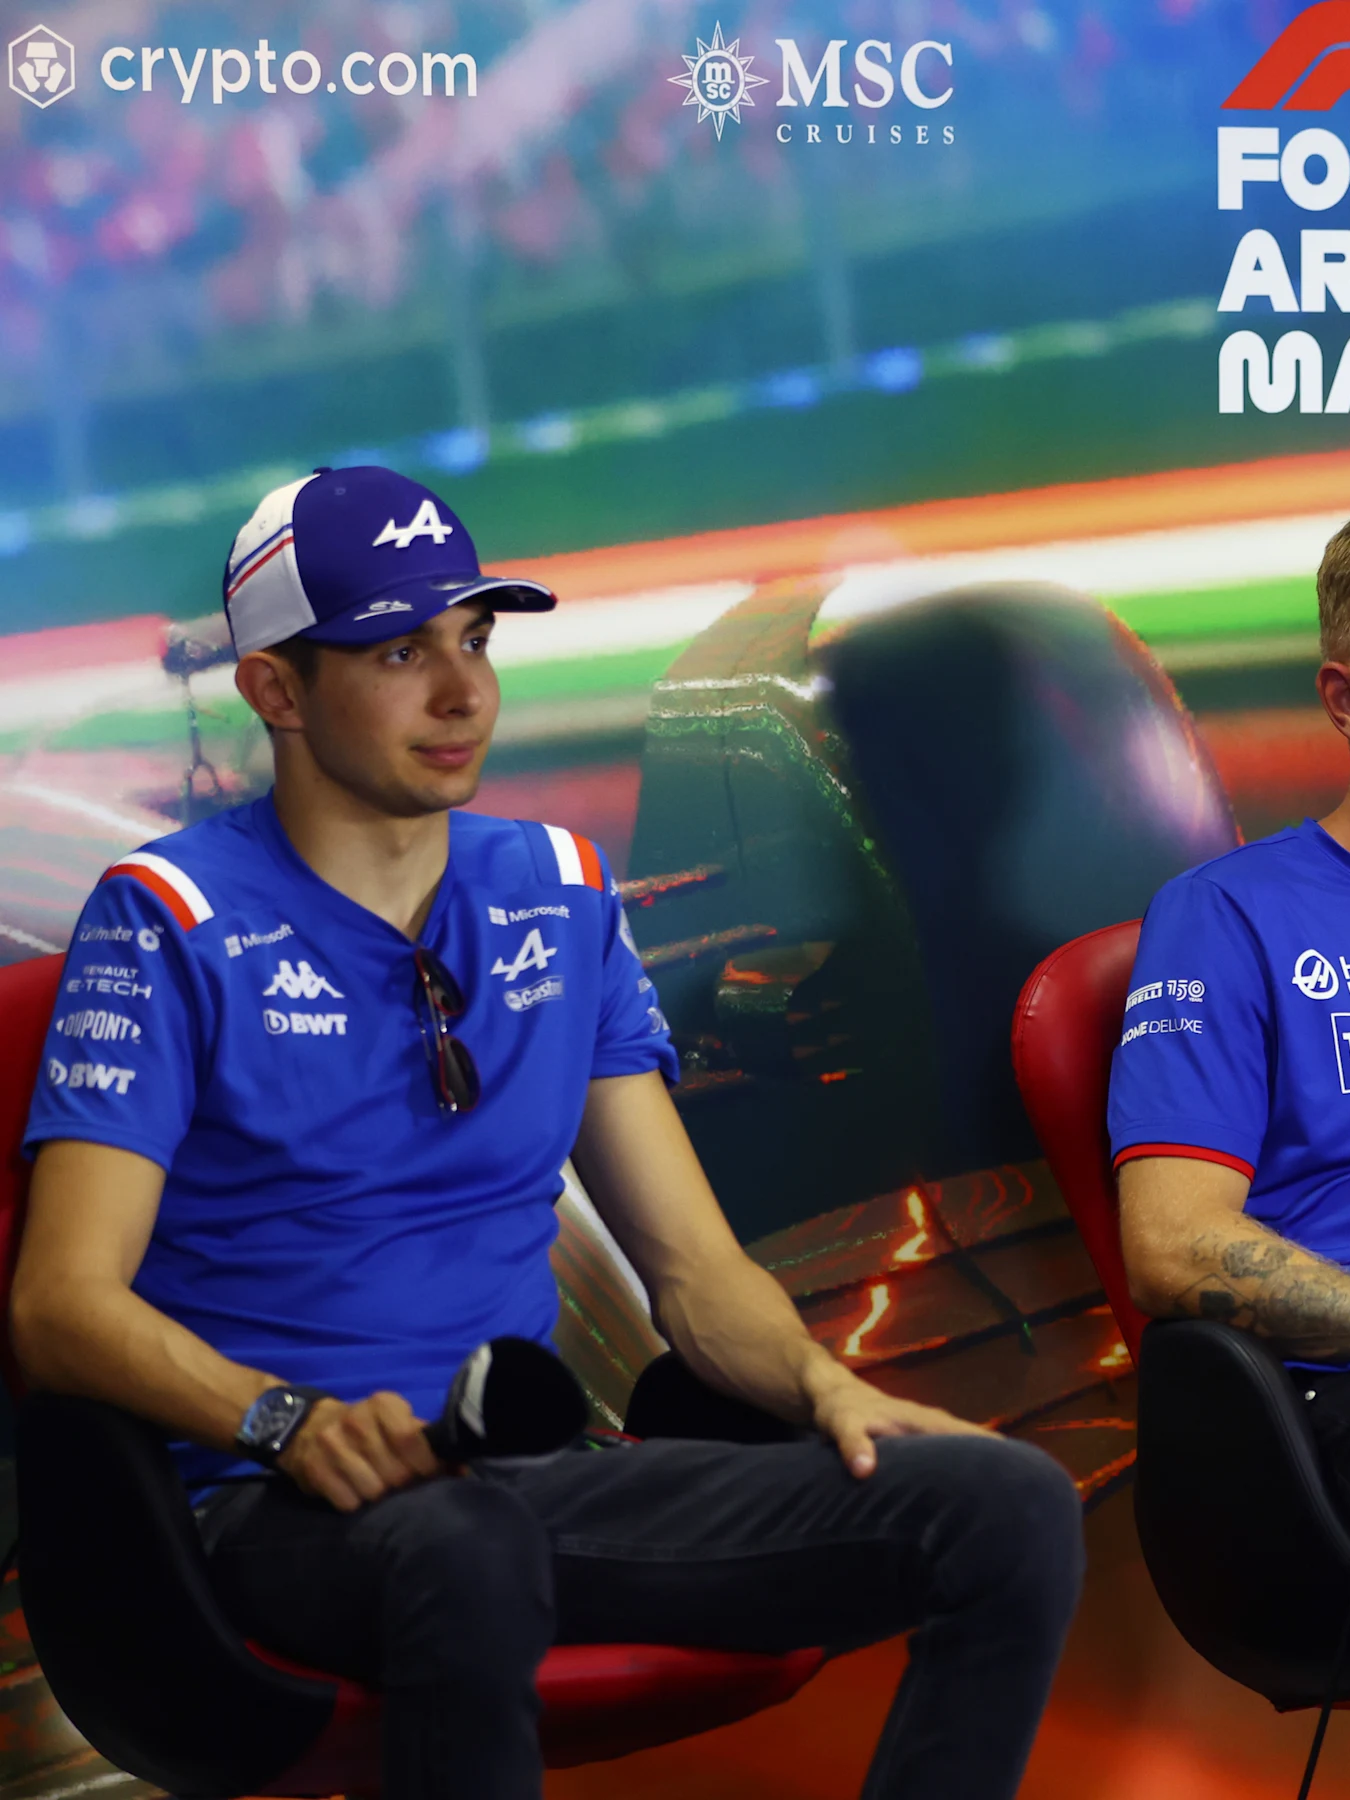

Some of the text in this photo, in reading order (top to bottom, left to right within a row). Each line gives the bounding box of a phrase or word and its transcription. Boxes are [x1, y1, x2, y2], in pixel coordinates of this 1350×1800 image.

[100, 39, 478, 104] crypto.com
[774, 38, 954, 109] MSC
[776, 124, 955, 145] CRUISES
[509, 905, 571, 923] Microsoft
[289, 1011, 348, 1036] BWT
[1149, 1017, 1204, 1035] DELUXE
[68, 1063, 136, 1096] BWT
